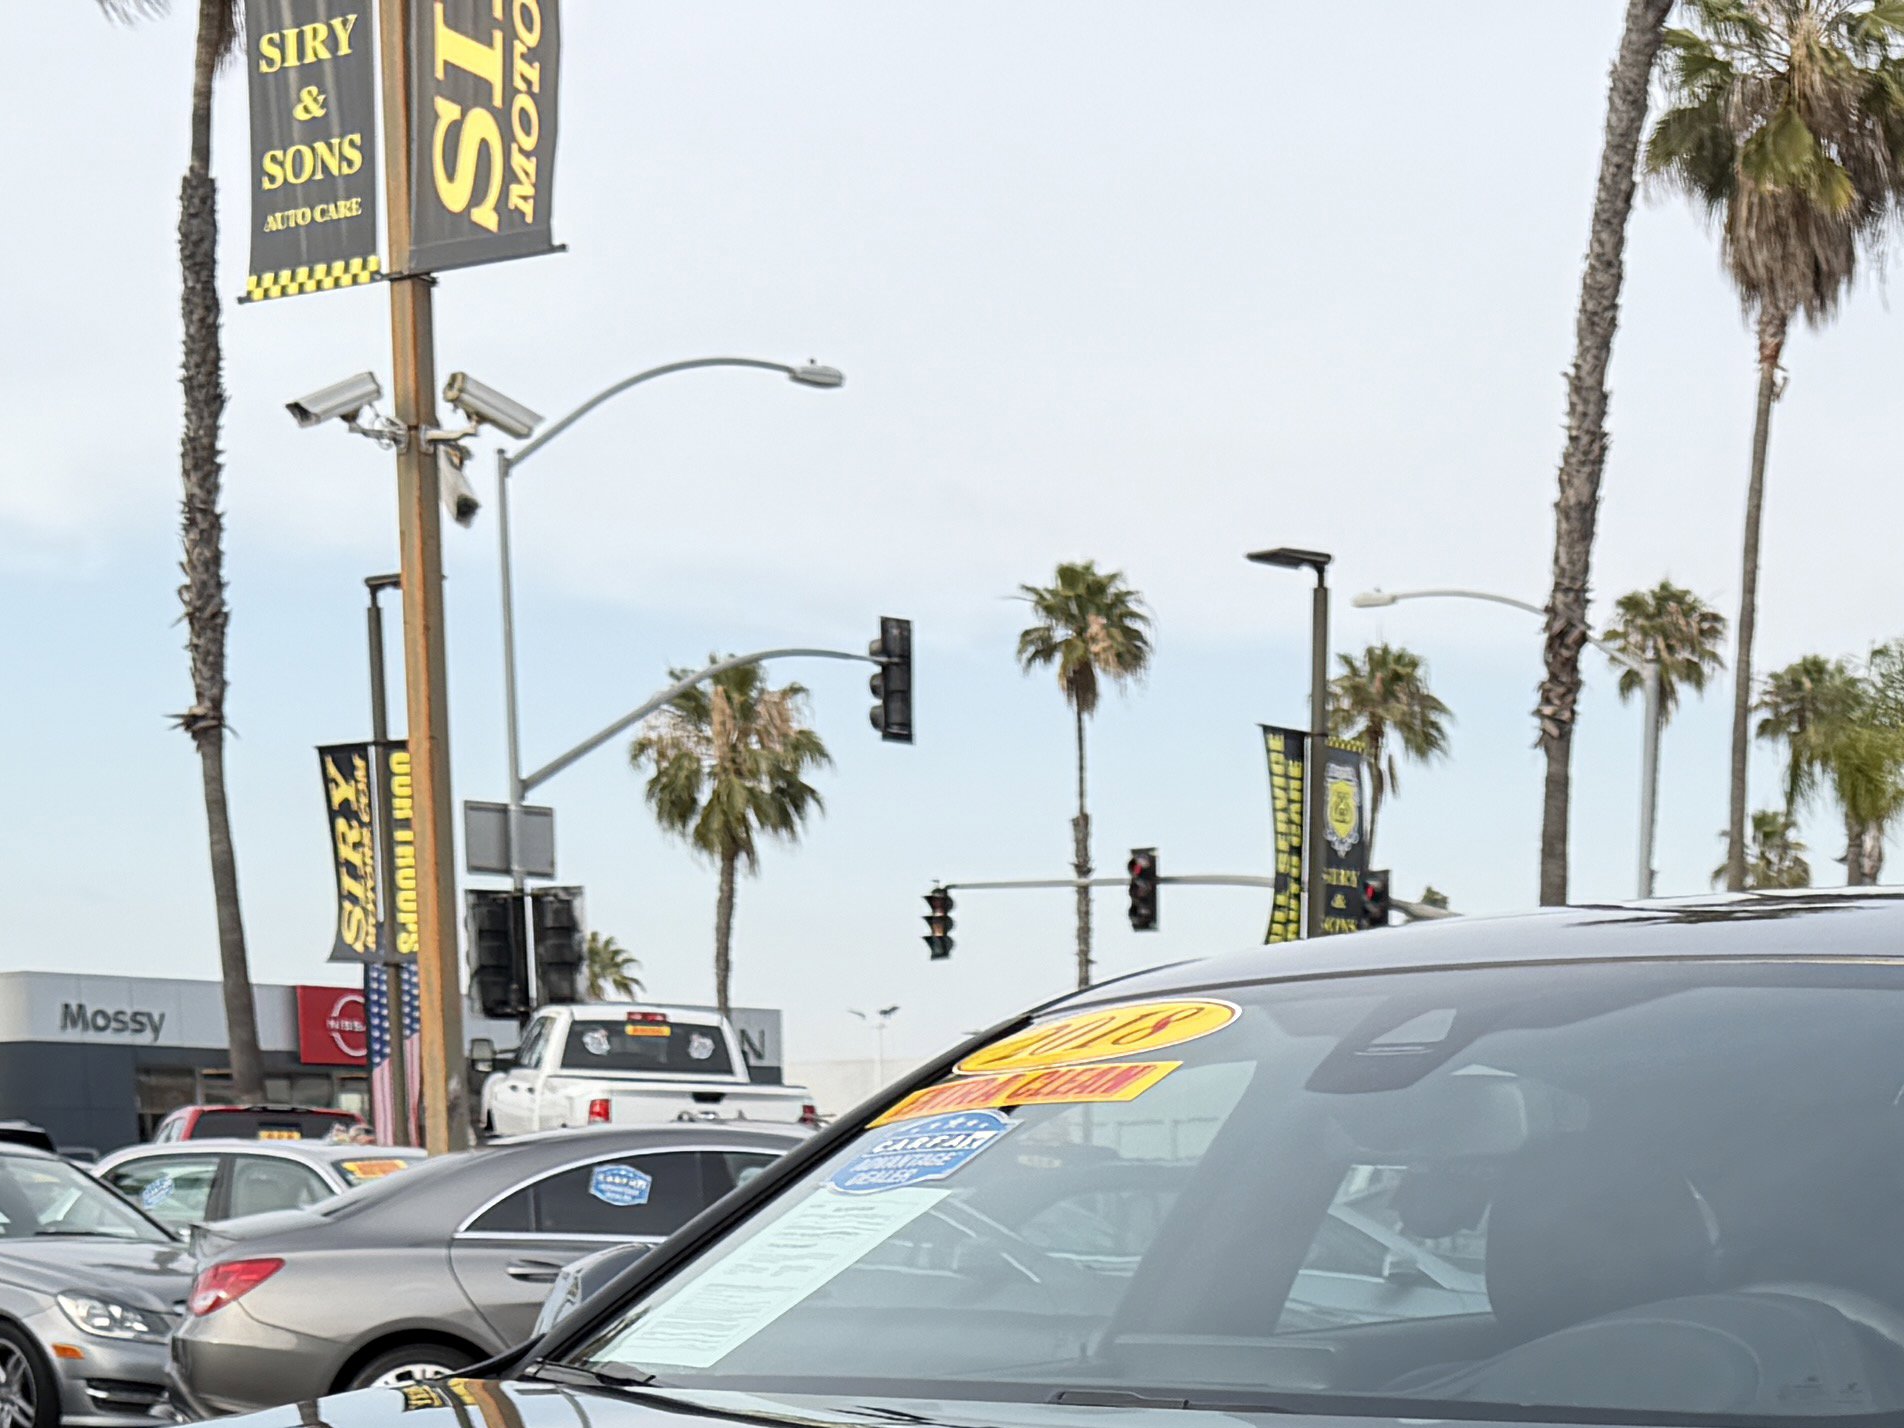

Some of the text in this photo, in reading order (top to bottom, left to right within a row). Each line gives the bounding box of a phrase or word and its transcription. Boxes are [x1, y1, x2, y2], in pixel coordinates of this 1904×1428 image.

[258, 14, 358, 73] SIRY
[292, 85, 327, 121] &
[261, 133, 363, 190] SONS
[264, 197, 362, 232] AUTO CARE
[324, 753, 365, 954] SIRY
[60, 1002, 166, 1042] Mossy
[972, 1005, 1204, 1067] 2018
[1005, 1065, 1157, 1103] CLEAN
[873, 1131, 998, 1153] CARFAX
